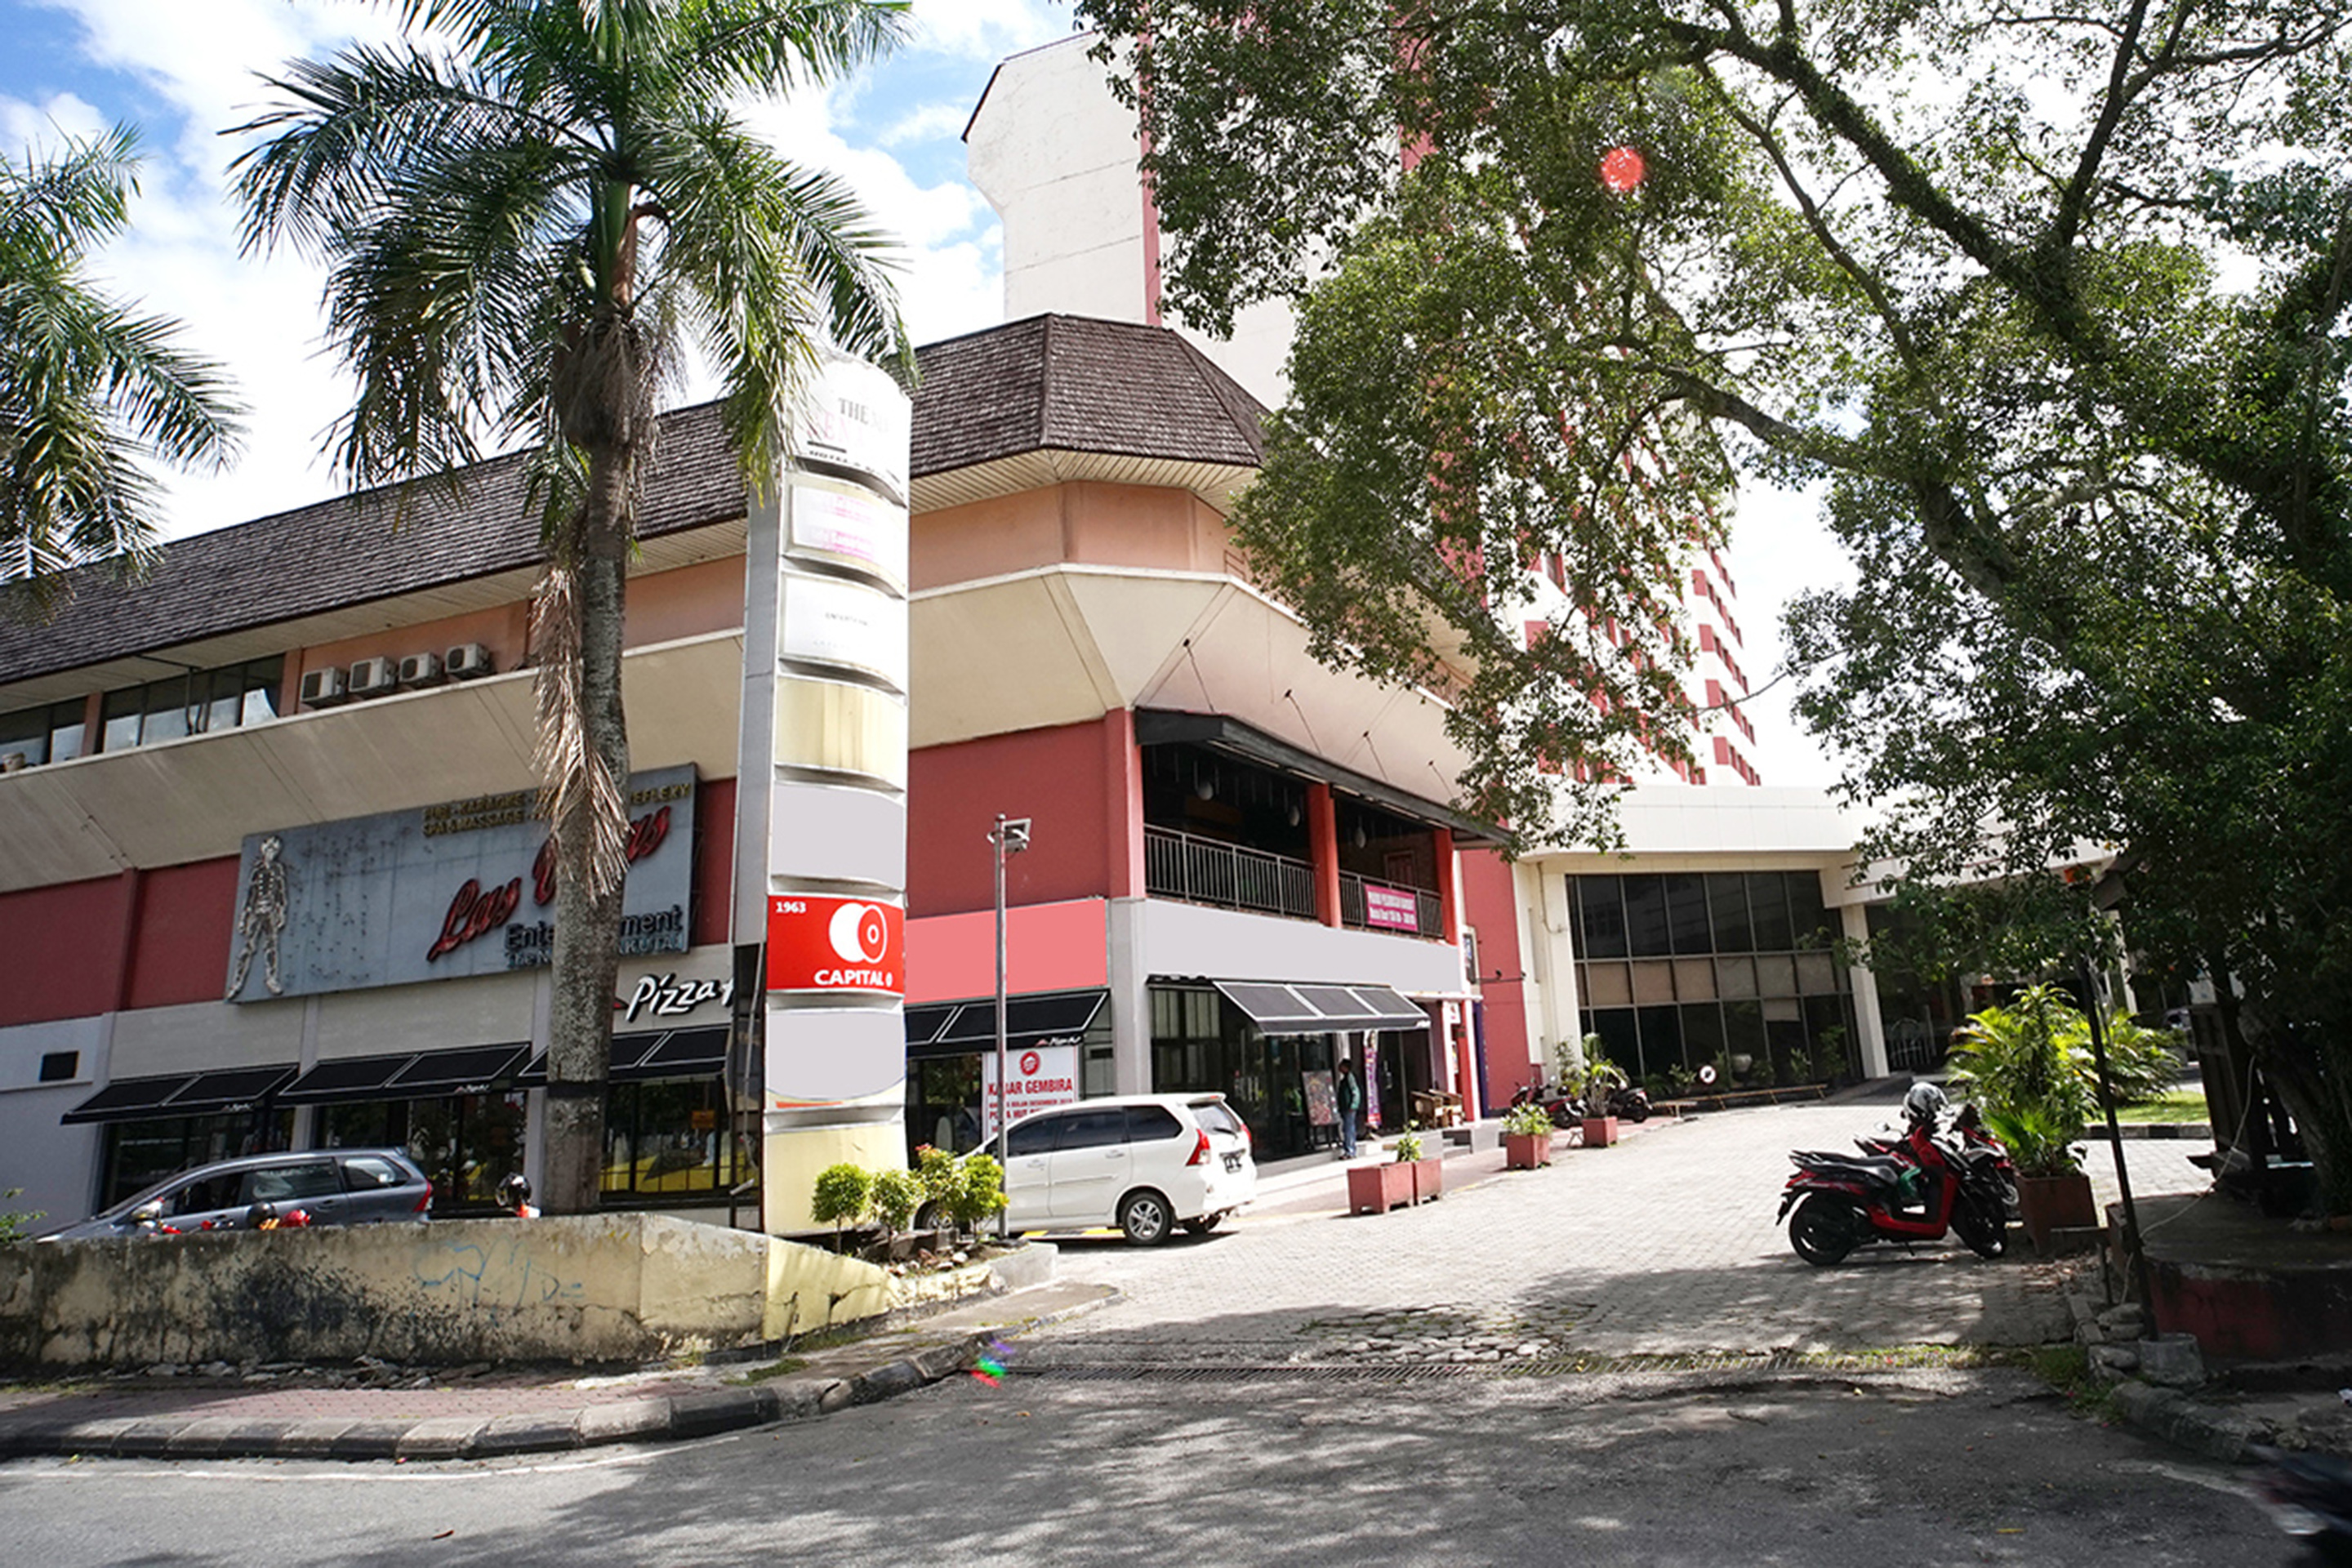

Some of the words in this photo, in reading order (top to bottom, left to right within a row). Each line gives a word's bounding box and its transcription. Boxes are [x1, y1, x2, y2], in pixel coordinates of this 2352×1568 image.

[776, 902, 806, 913] 1963
[814, 969, 884, 986] CAPITAL
[626, 973, 719, 1022] Pizza
[988, 1080, 1022, 1095] KAR
[1025, 1078, 1073, 1094] GEMBIRA
